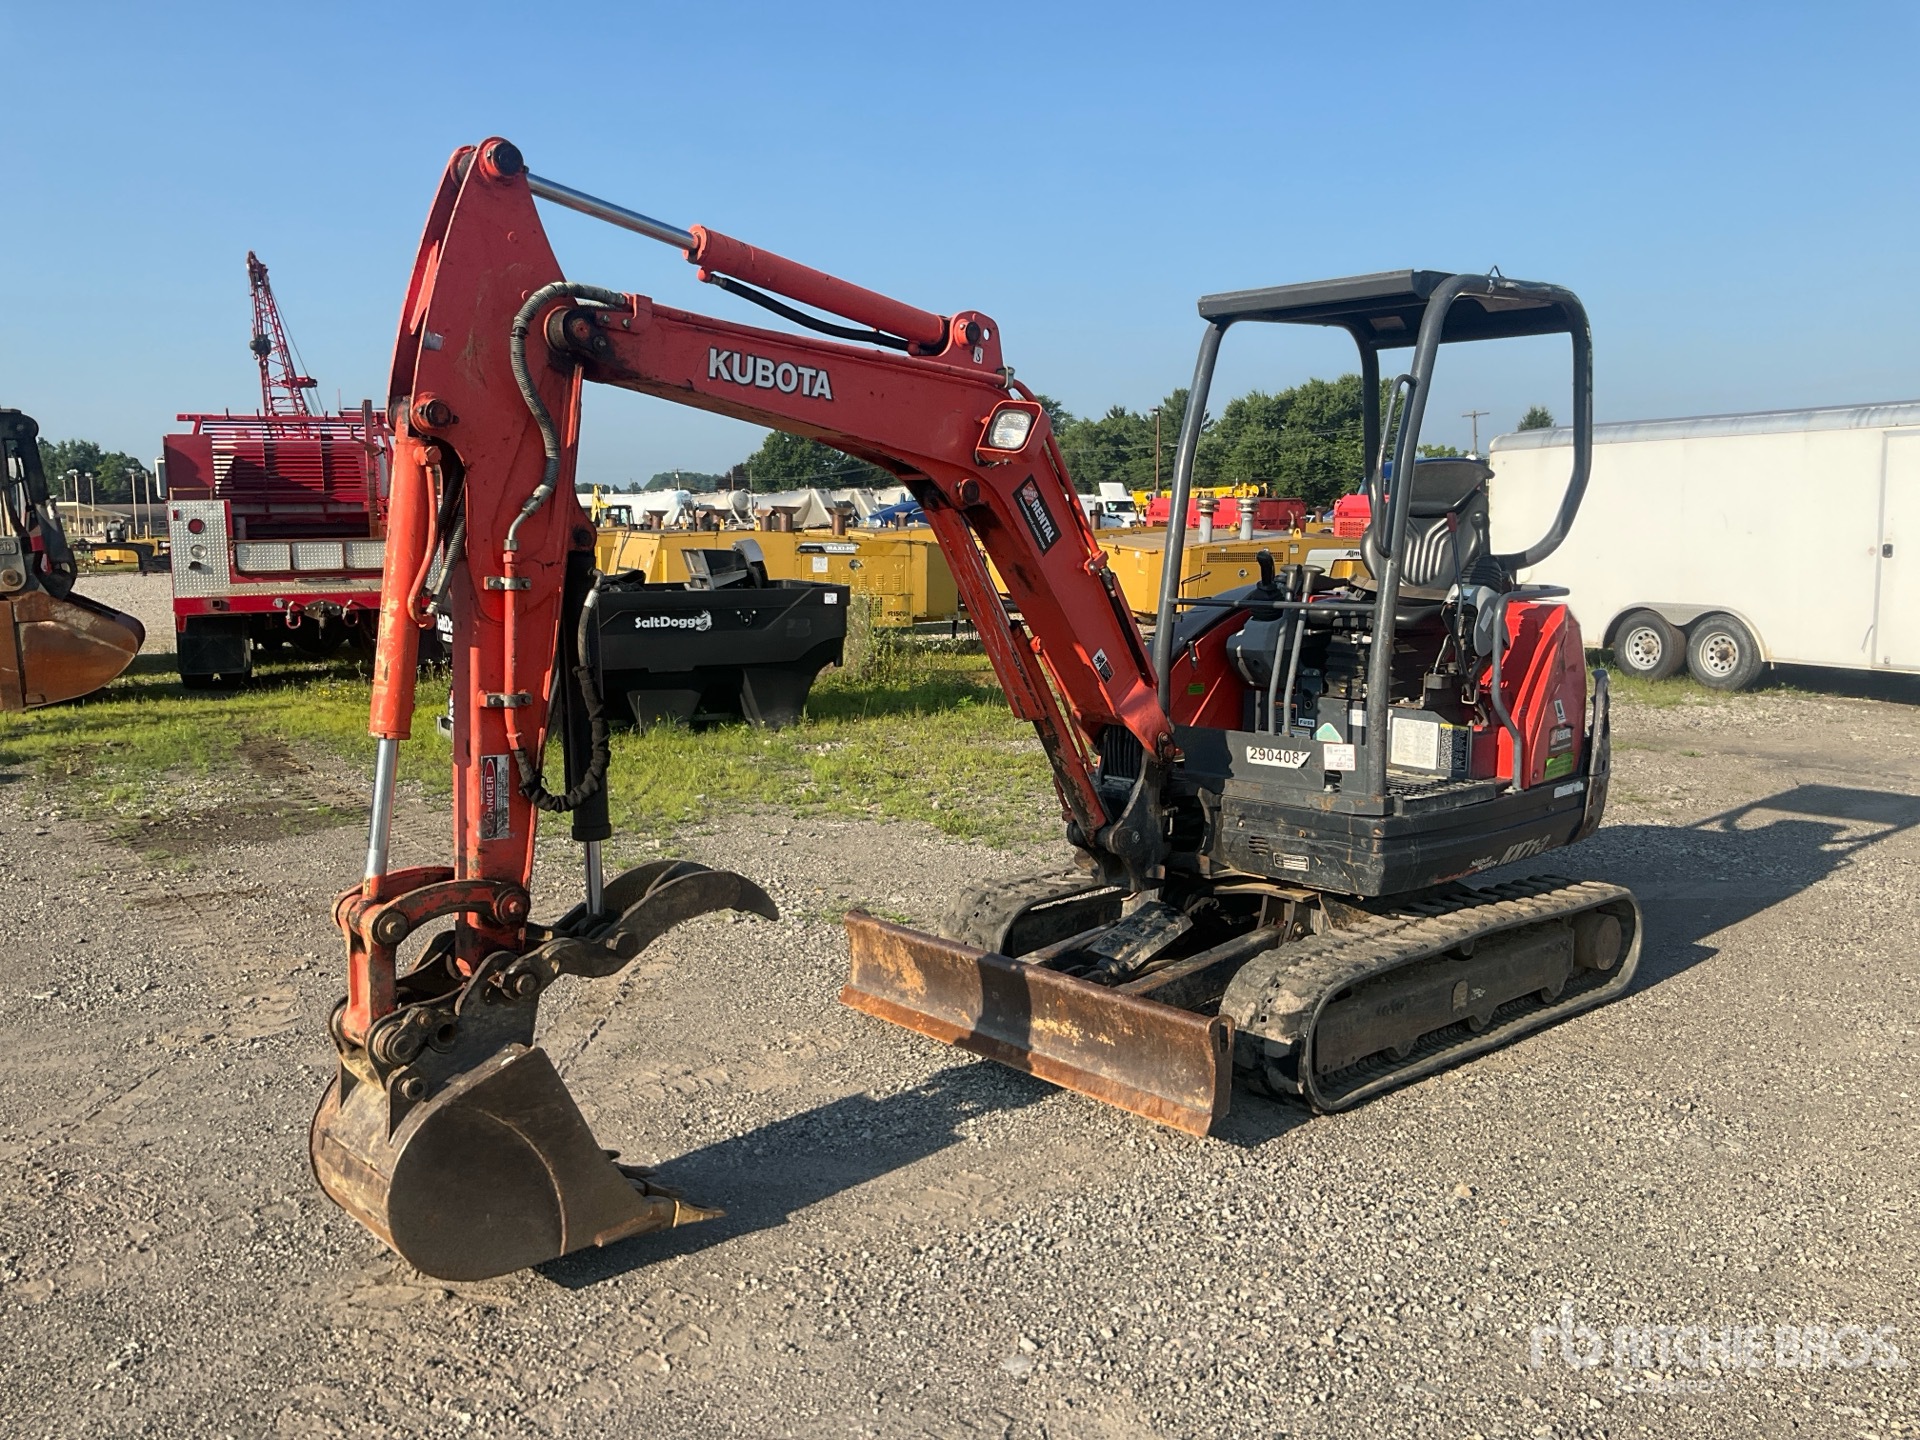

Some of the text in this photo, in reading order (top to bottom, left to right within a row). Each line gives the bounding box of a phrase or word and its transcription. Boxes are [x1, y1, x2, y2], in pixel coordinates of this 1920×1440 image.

[708, 347, 834, 401] KUBOTA
[1030, 499, 1056, 543] RENTAL
[1250, 747, 1307, 765] 290408
[486, 776, 494, 820] DANGER
